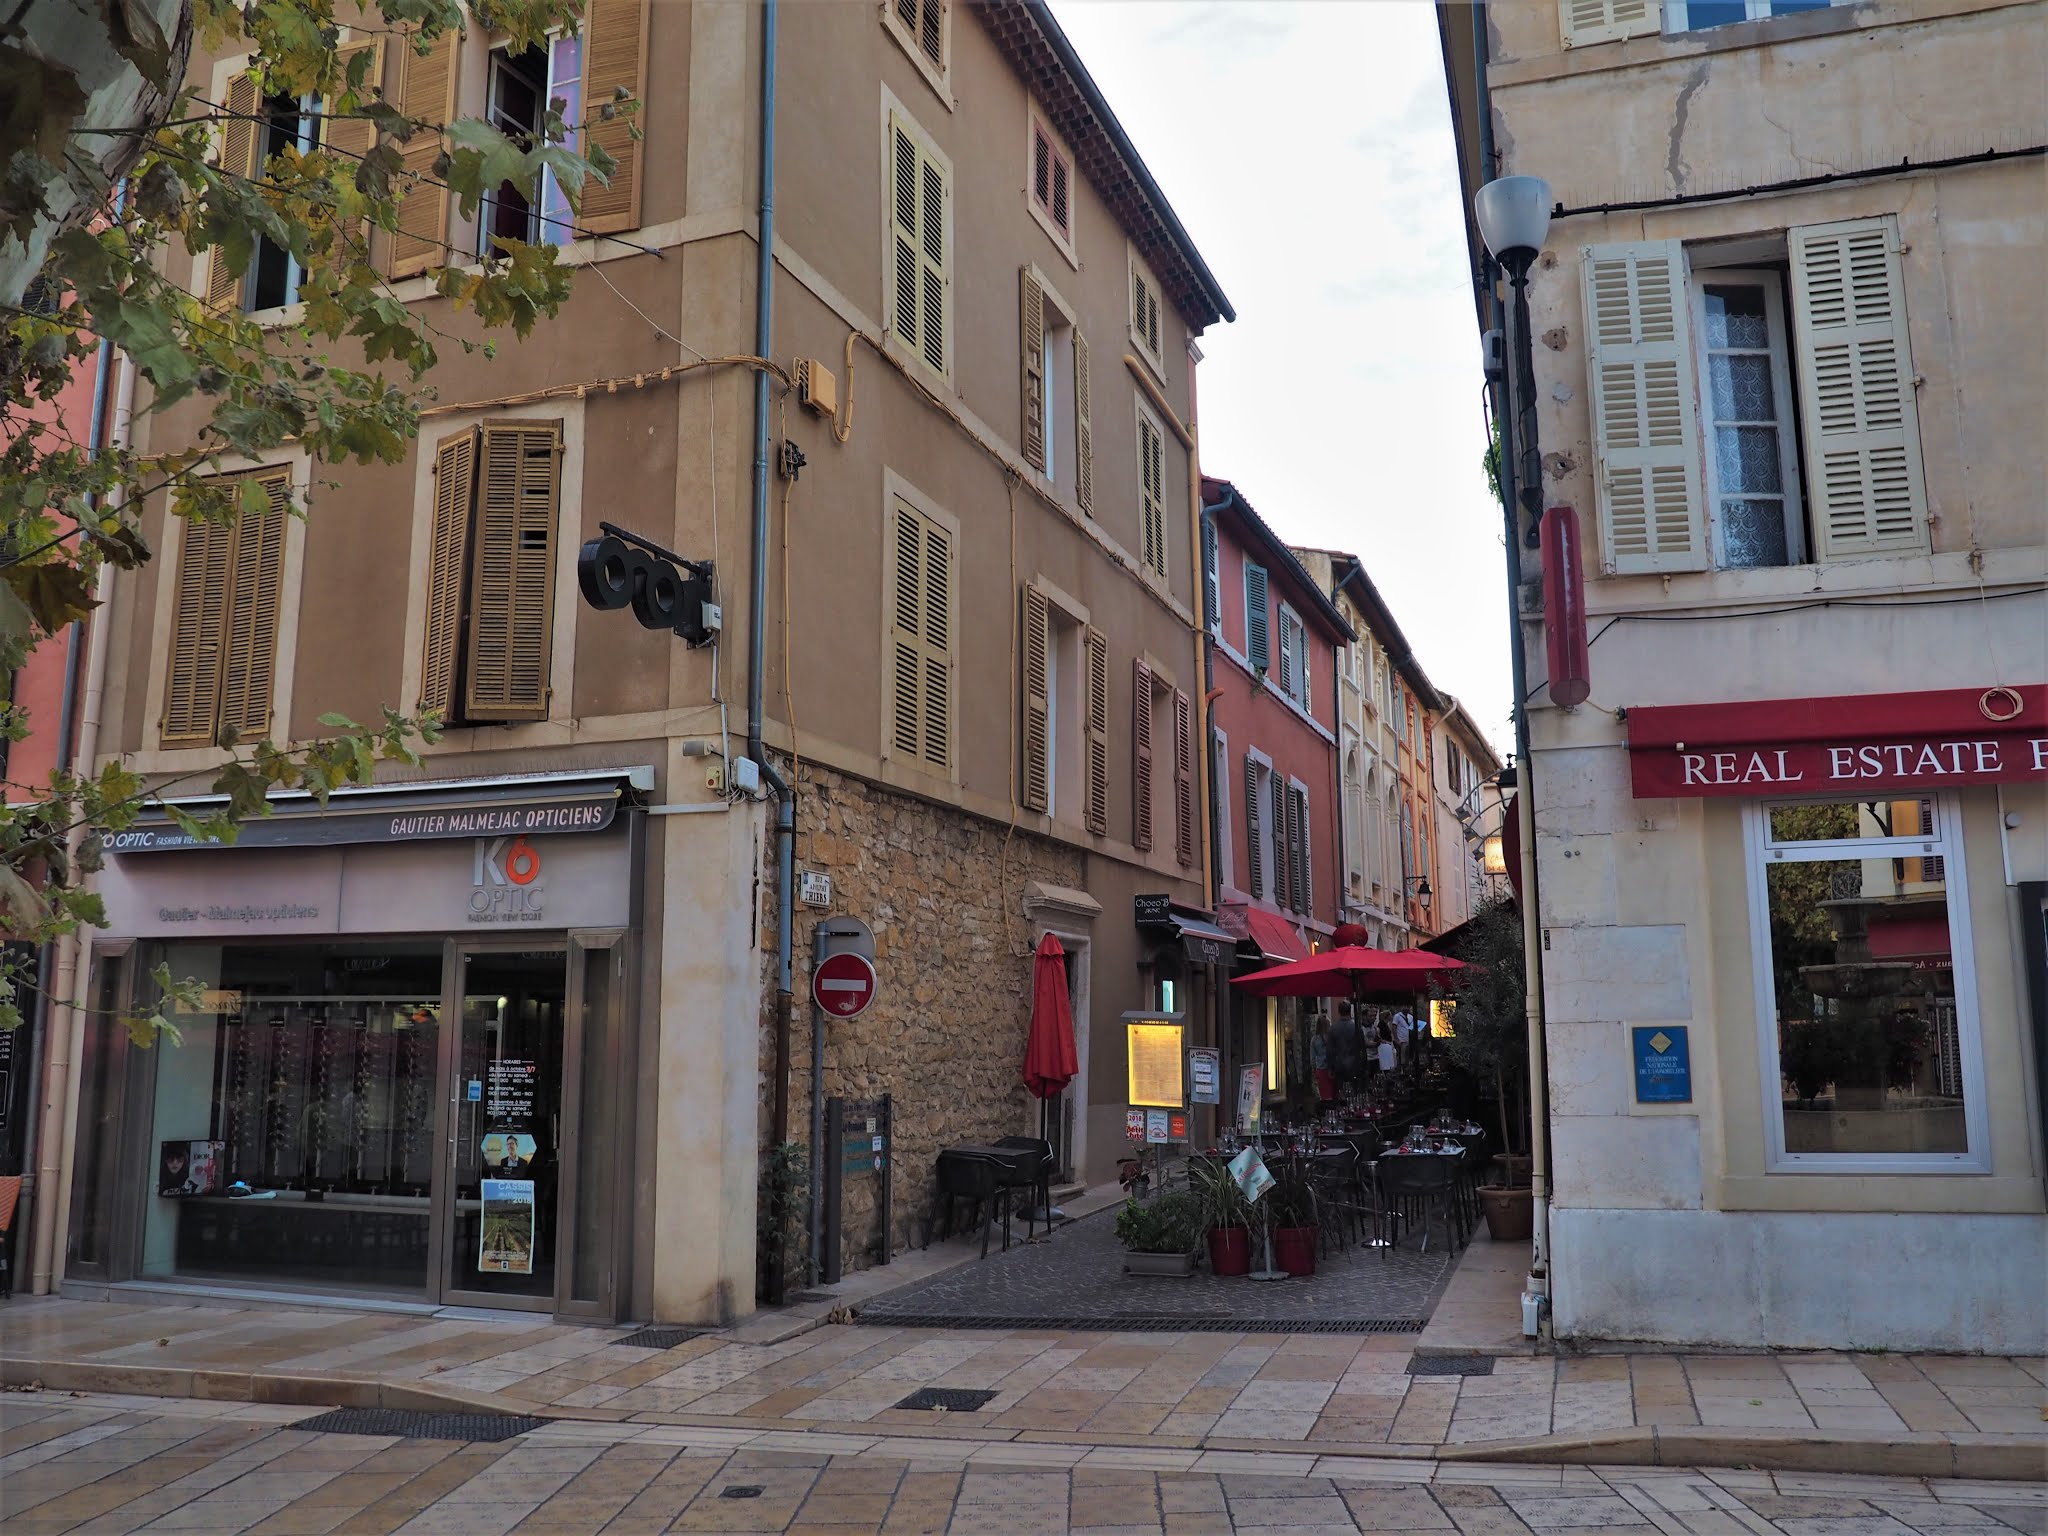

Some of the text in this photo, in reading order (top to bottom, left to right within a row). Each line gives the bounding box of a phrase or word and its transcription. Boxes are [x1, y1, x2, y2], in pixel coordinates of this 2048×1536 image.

[1680, 750, 1803, 785] REAL
[1827, 740, 2003, 779] ESTATE
[390, 806, 603, 835] GAUTIER MALMEJAC OPTICIENS
[116, 832, 155, 847] OPTIC
[470, 887, 543, 913] OPTIC
[805, 891, 827, 903] THIERS
[498, 1182, 532, 1191] CASSIS
